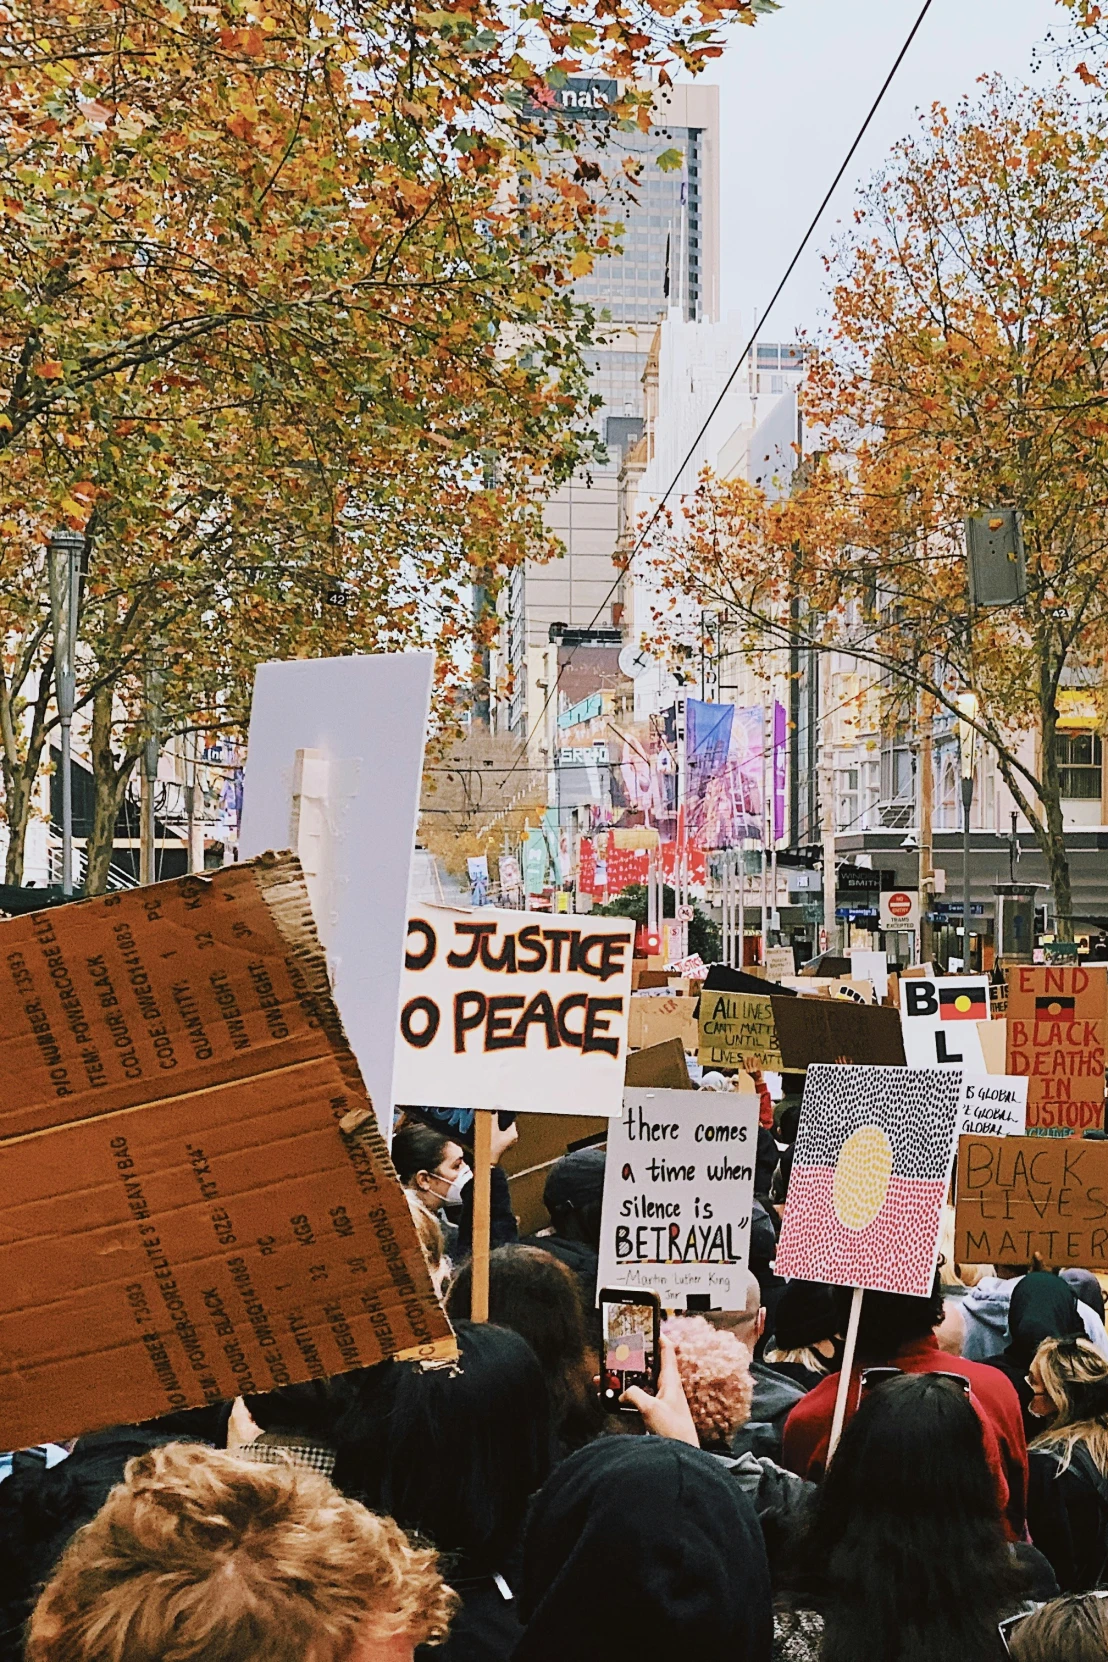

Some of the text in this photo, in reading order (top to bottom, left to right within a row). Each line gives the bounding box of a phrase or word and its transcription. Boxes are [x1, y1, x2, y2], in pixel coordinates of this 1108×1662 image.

[561, 87, 608, 108] nab
[330, 595, 344, 604] 42
[841, 872, 889, 880] WINDSOR
[848, 879, 881, 887] SMITH
[143, 899, 164, 921] PC
[193, 930, 215, 950] 32
[405, 918, 631, 982] O JUSTICE
[41, 945, 92, 1044] POWERCORE
[1019, 967, 1089, 994] END
[209, 968, 251, 1050] N/WEIGHT:
[248, 958, 290, 1040] G/WEIGHT:
[713, 997, 772, 1020] ALL LIVES
[906, 981, 937, 1016] B
[85, 954, 143, 1079] COLOUR: BLACK
[172, 979, 213, 1061] QUANTITY:
[401, 990, 623, 1059] O PEACE
[704, 1021, 737, 1035] CANT
[1012, 1019, 1099, 1046] BLACK
[149, 1021, 178, 1070] CODE:
[711, 1047, 744, 1063] LIVES
[754, 1052, 782, 1066] MATT
[725, 1035, 764, 1047] UNTIL
[935, 1031, 962, 1063] L
[81, 1045, 108, 1088] ITEM:
[1011, 1049, 1105, 1076] DEATHS
[49, 1066, 73, 1097] P/O
[978, 1087, 1021, 1103] GLOBAL
[1041, 1077, 1071, 1099] IN
[624, 1109, 747, 1143] there comes
[962, 1119, 1010, 1136] GLOBAL
[1026, 1101, 1105, 1129] USTODY
[108, 1134, 134, 1170] BAG
[966, 1143, 1087, 1190] BLACK
[622, 1157, 752, 1183] a time when
[122, 1170, 150, 1221] HEAVY
[620, 1197, 713, 1219] silence is
[210, 1205, 237, 1246] SIZE:
[143, 1237, 171, 1279] ELITE
[257, 1234, 276, 1256] PC
[367, 1202, 416, 1296] DIMENSIONS:
[289, 1212, 361, 1366] /WEIGHT: 32 KGS
[328, 1204, 398, 1356] /WEIGHT: 30 KGS
[665, 1289, 681, 1300] Jnr
[674, 1274, 701, 1285] Luther
[708, 1272, 730, 1292] King
[159, 1279, 209, 1371] POWERCORE
[201, 1286, 256, 1394] OLOUR: BLACK
[401, 1297, 435, 1356] CARTON
[287, 1309, 325, 1378] UANTITY:
[264, 1349, 291, 1386] ODE:
